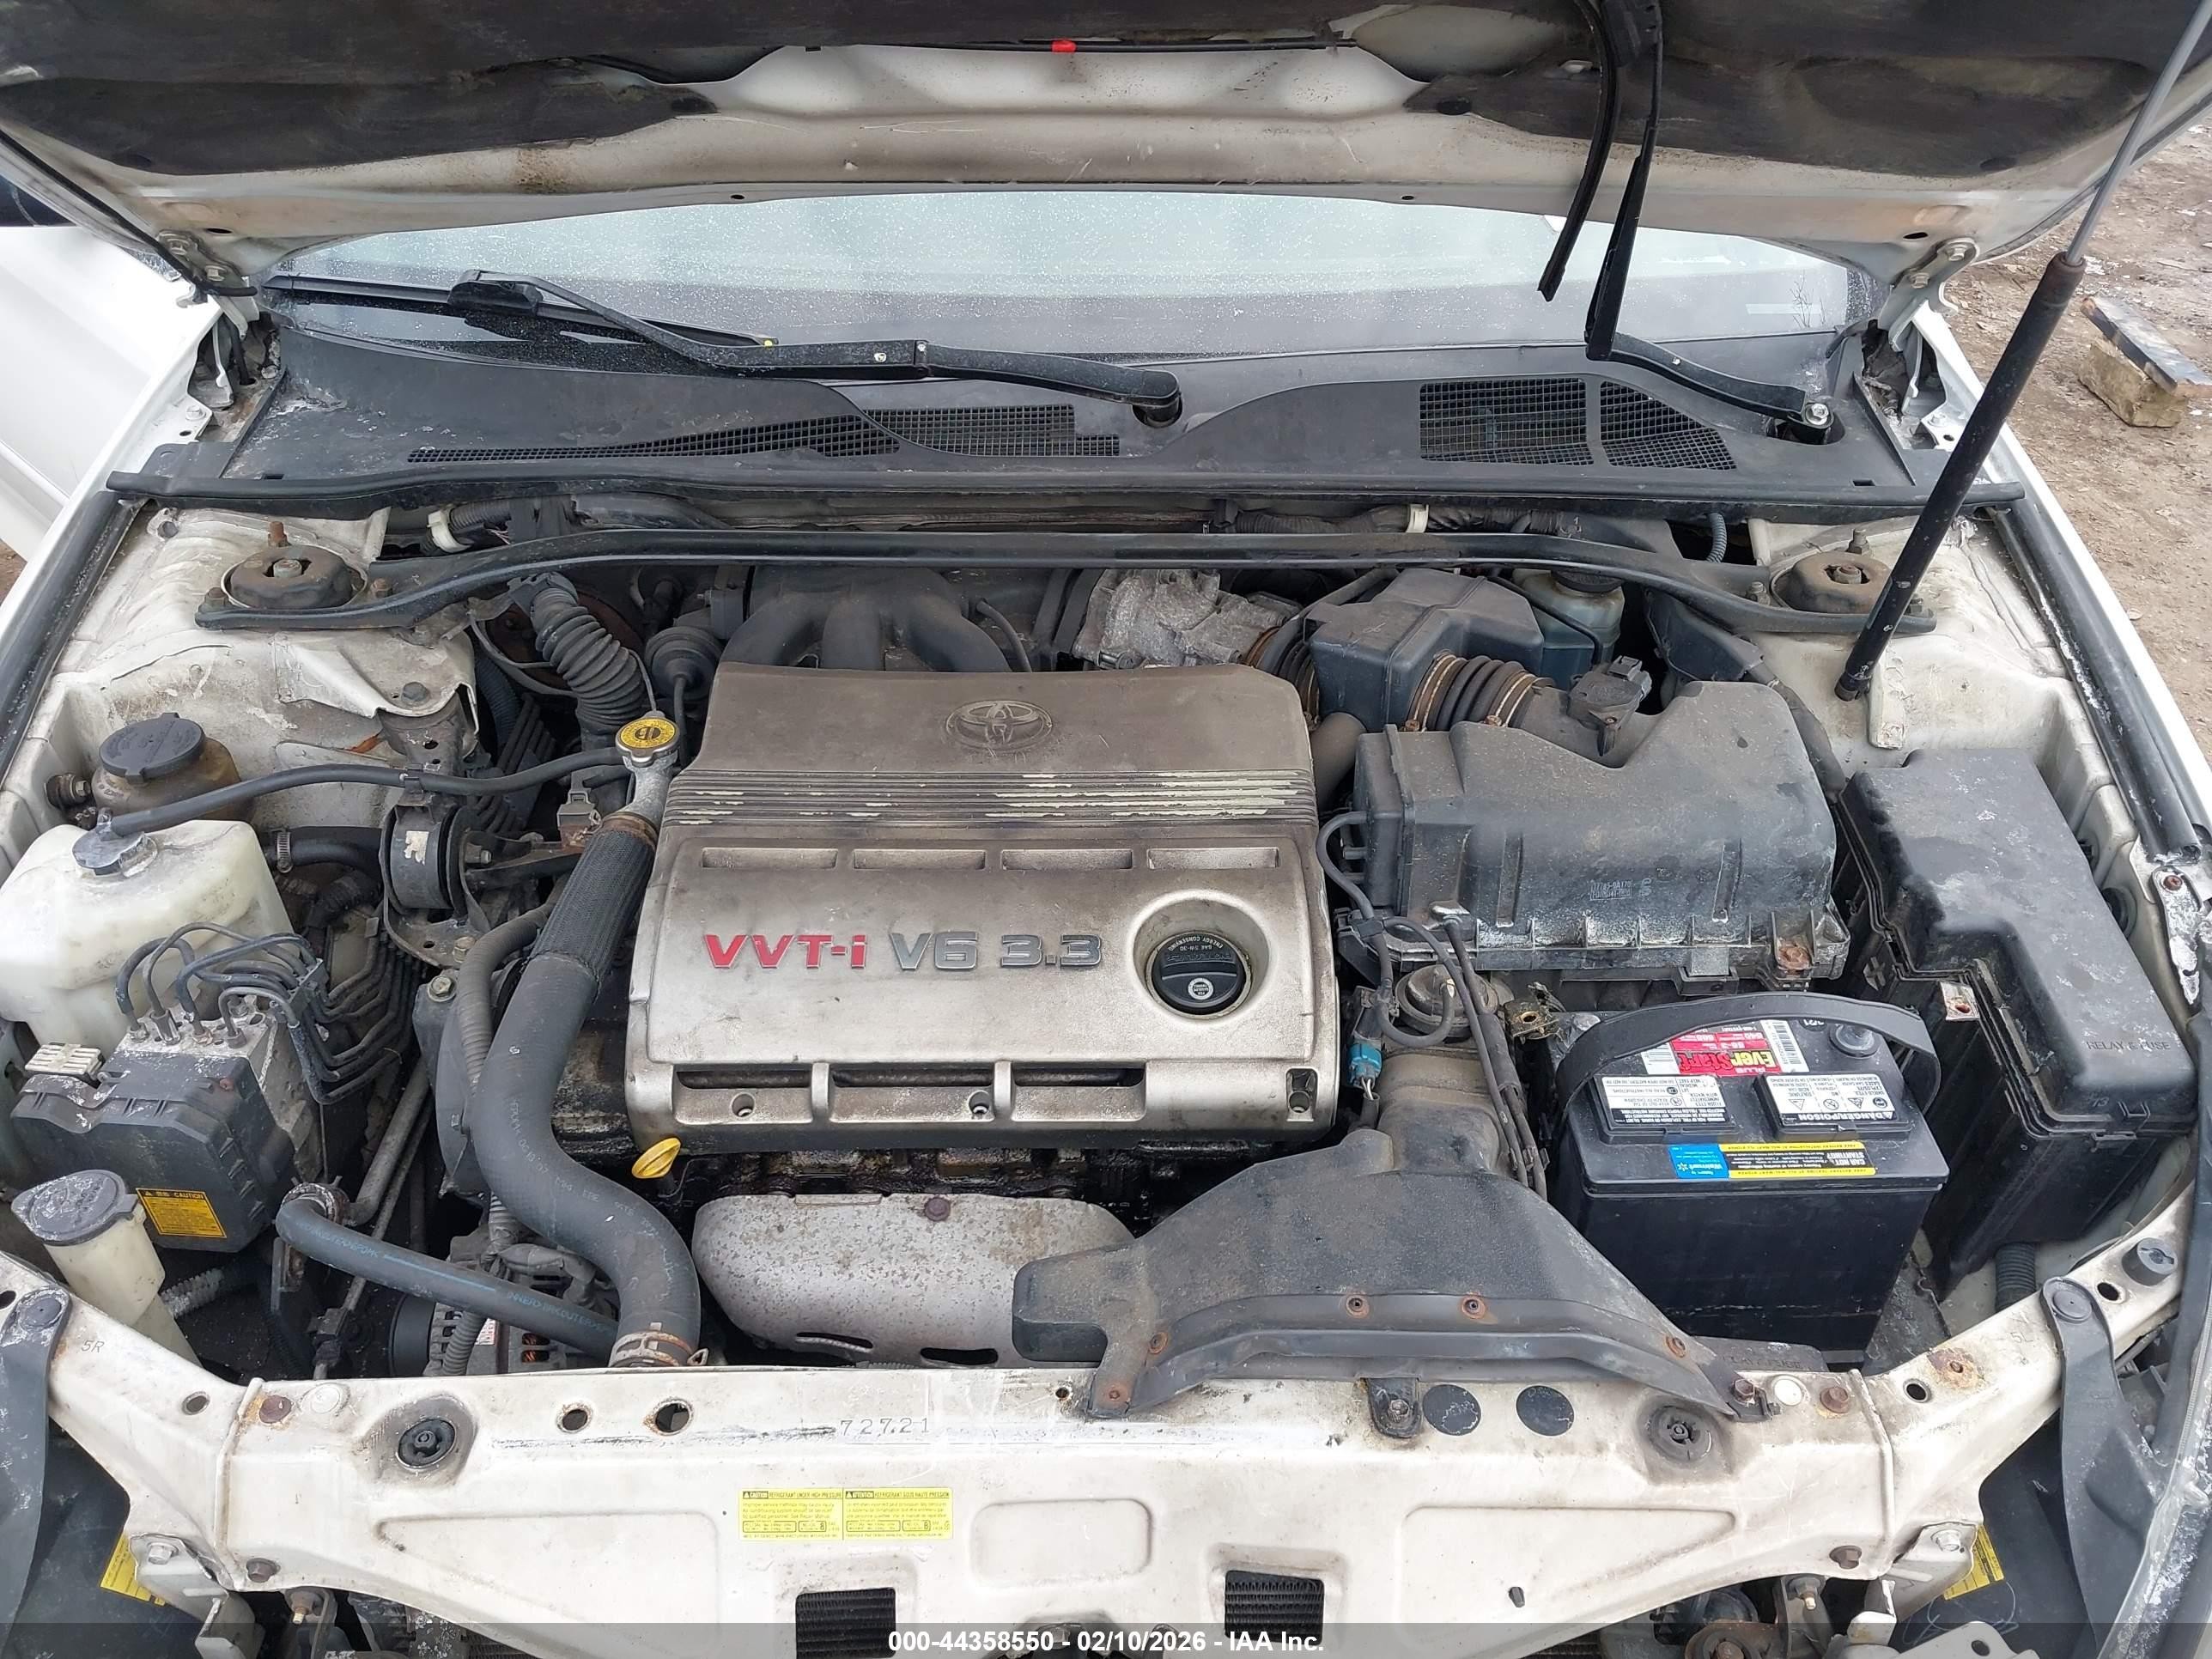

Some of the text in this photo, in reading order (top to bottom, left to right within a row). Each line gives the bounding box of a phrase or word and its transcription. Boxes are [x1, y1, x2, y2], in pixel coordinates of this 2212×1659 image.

[1202, 936, 1224, 950] ENERGY
[703, 931, 1103, 972] VVT-i V6 3.3
[2087, 1041, 2124, 1050] RELAY
[1677, 1052, 1776, 1072] EverStart
[1798, 1112, 1884, 1121] DANGER/POISON
